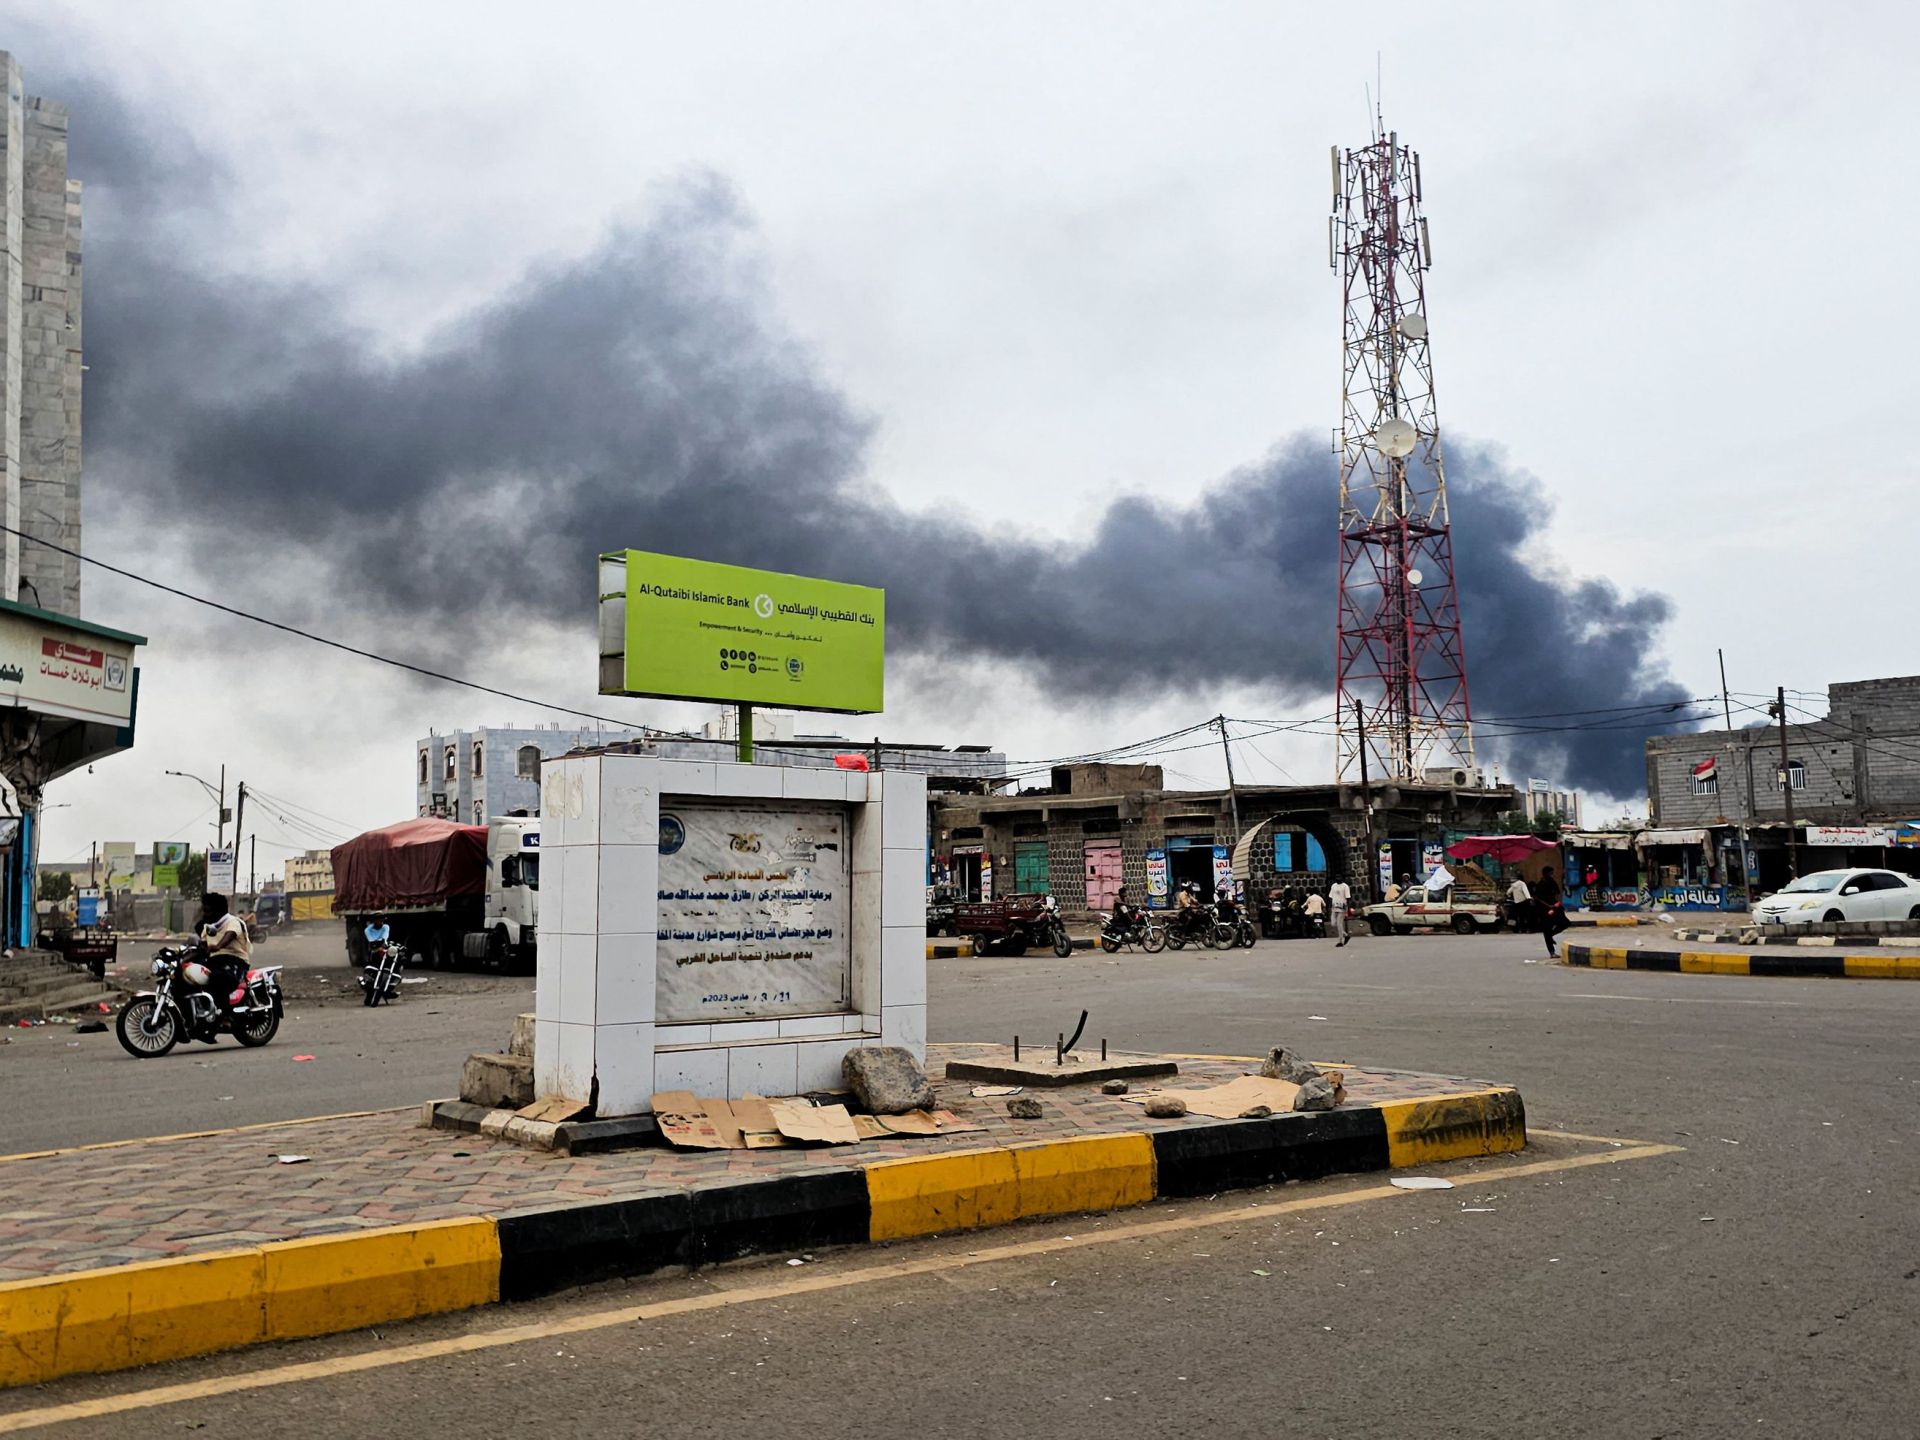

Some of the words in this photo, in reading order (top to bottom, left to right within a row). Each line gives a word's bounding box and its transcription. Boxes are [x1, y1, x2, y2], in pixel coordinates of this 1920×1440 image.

[640, 583, 690, 600] Al-Qutaibi
[692, 591, 724, 605] Islamic
[727, 595, 750, 608] Bank
[778, 603, 818, 619] الإسلامي
[820, 610, 857, 622] القطيبي
[860, 614, 875, 627] بنك
[699, 621, 736, 632] Empowerment
[742, 626, 763, 636] Security
[0, 664, 24, 684] محم
[706, 890, 729, 900] محمد
[731, 889, 750, 902] طارق
[809, 889, 832, 901] برعاية
[1688, 889, 1720, 908] بقالة
[673, 929, 694, 942] مدينة
[802, 929, 815, 939] حجر
[817, 926, 832, 938] وضع
[676, 952, 706, 968] الغربي
[707, 951, 737, 964] الساحل
[738, 949, 762, 963] تنمية
[764, 950, 791, 962] صندوق
[793, 951, 813, 961] بدعم
